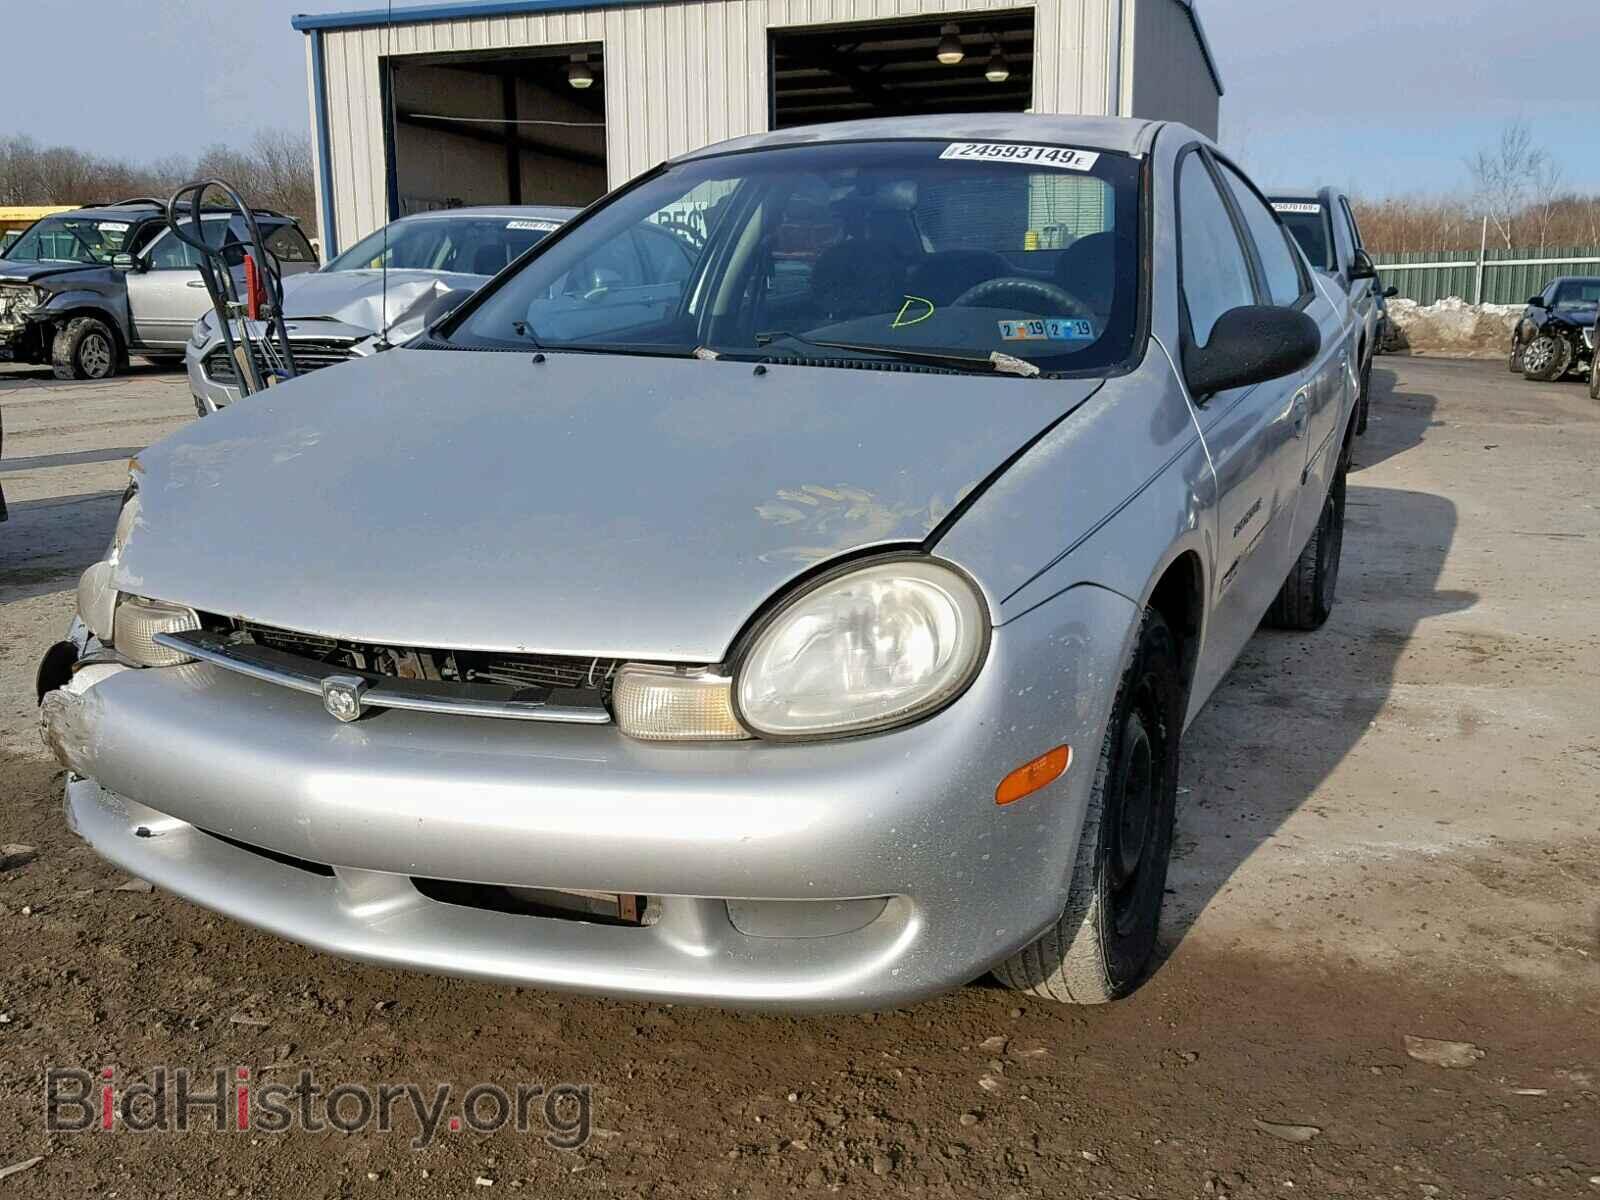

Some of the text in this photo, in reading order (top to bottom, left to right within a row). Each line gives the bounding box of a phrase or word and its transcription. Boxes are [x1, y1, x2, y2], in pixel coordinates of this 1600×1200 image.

[959, 143, 1076, 163] 24593149
[891, 294, 935, 329] D
[1030, 321, 1045, 335] 19
[1075, 321, 1090, 335] 19
